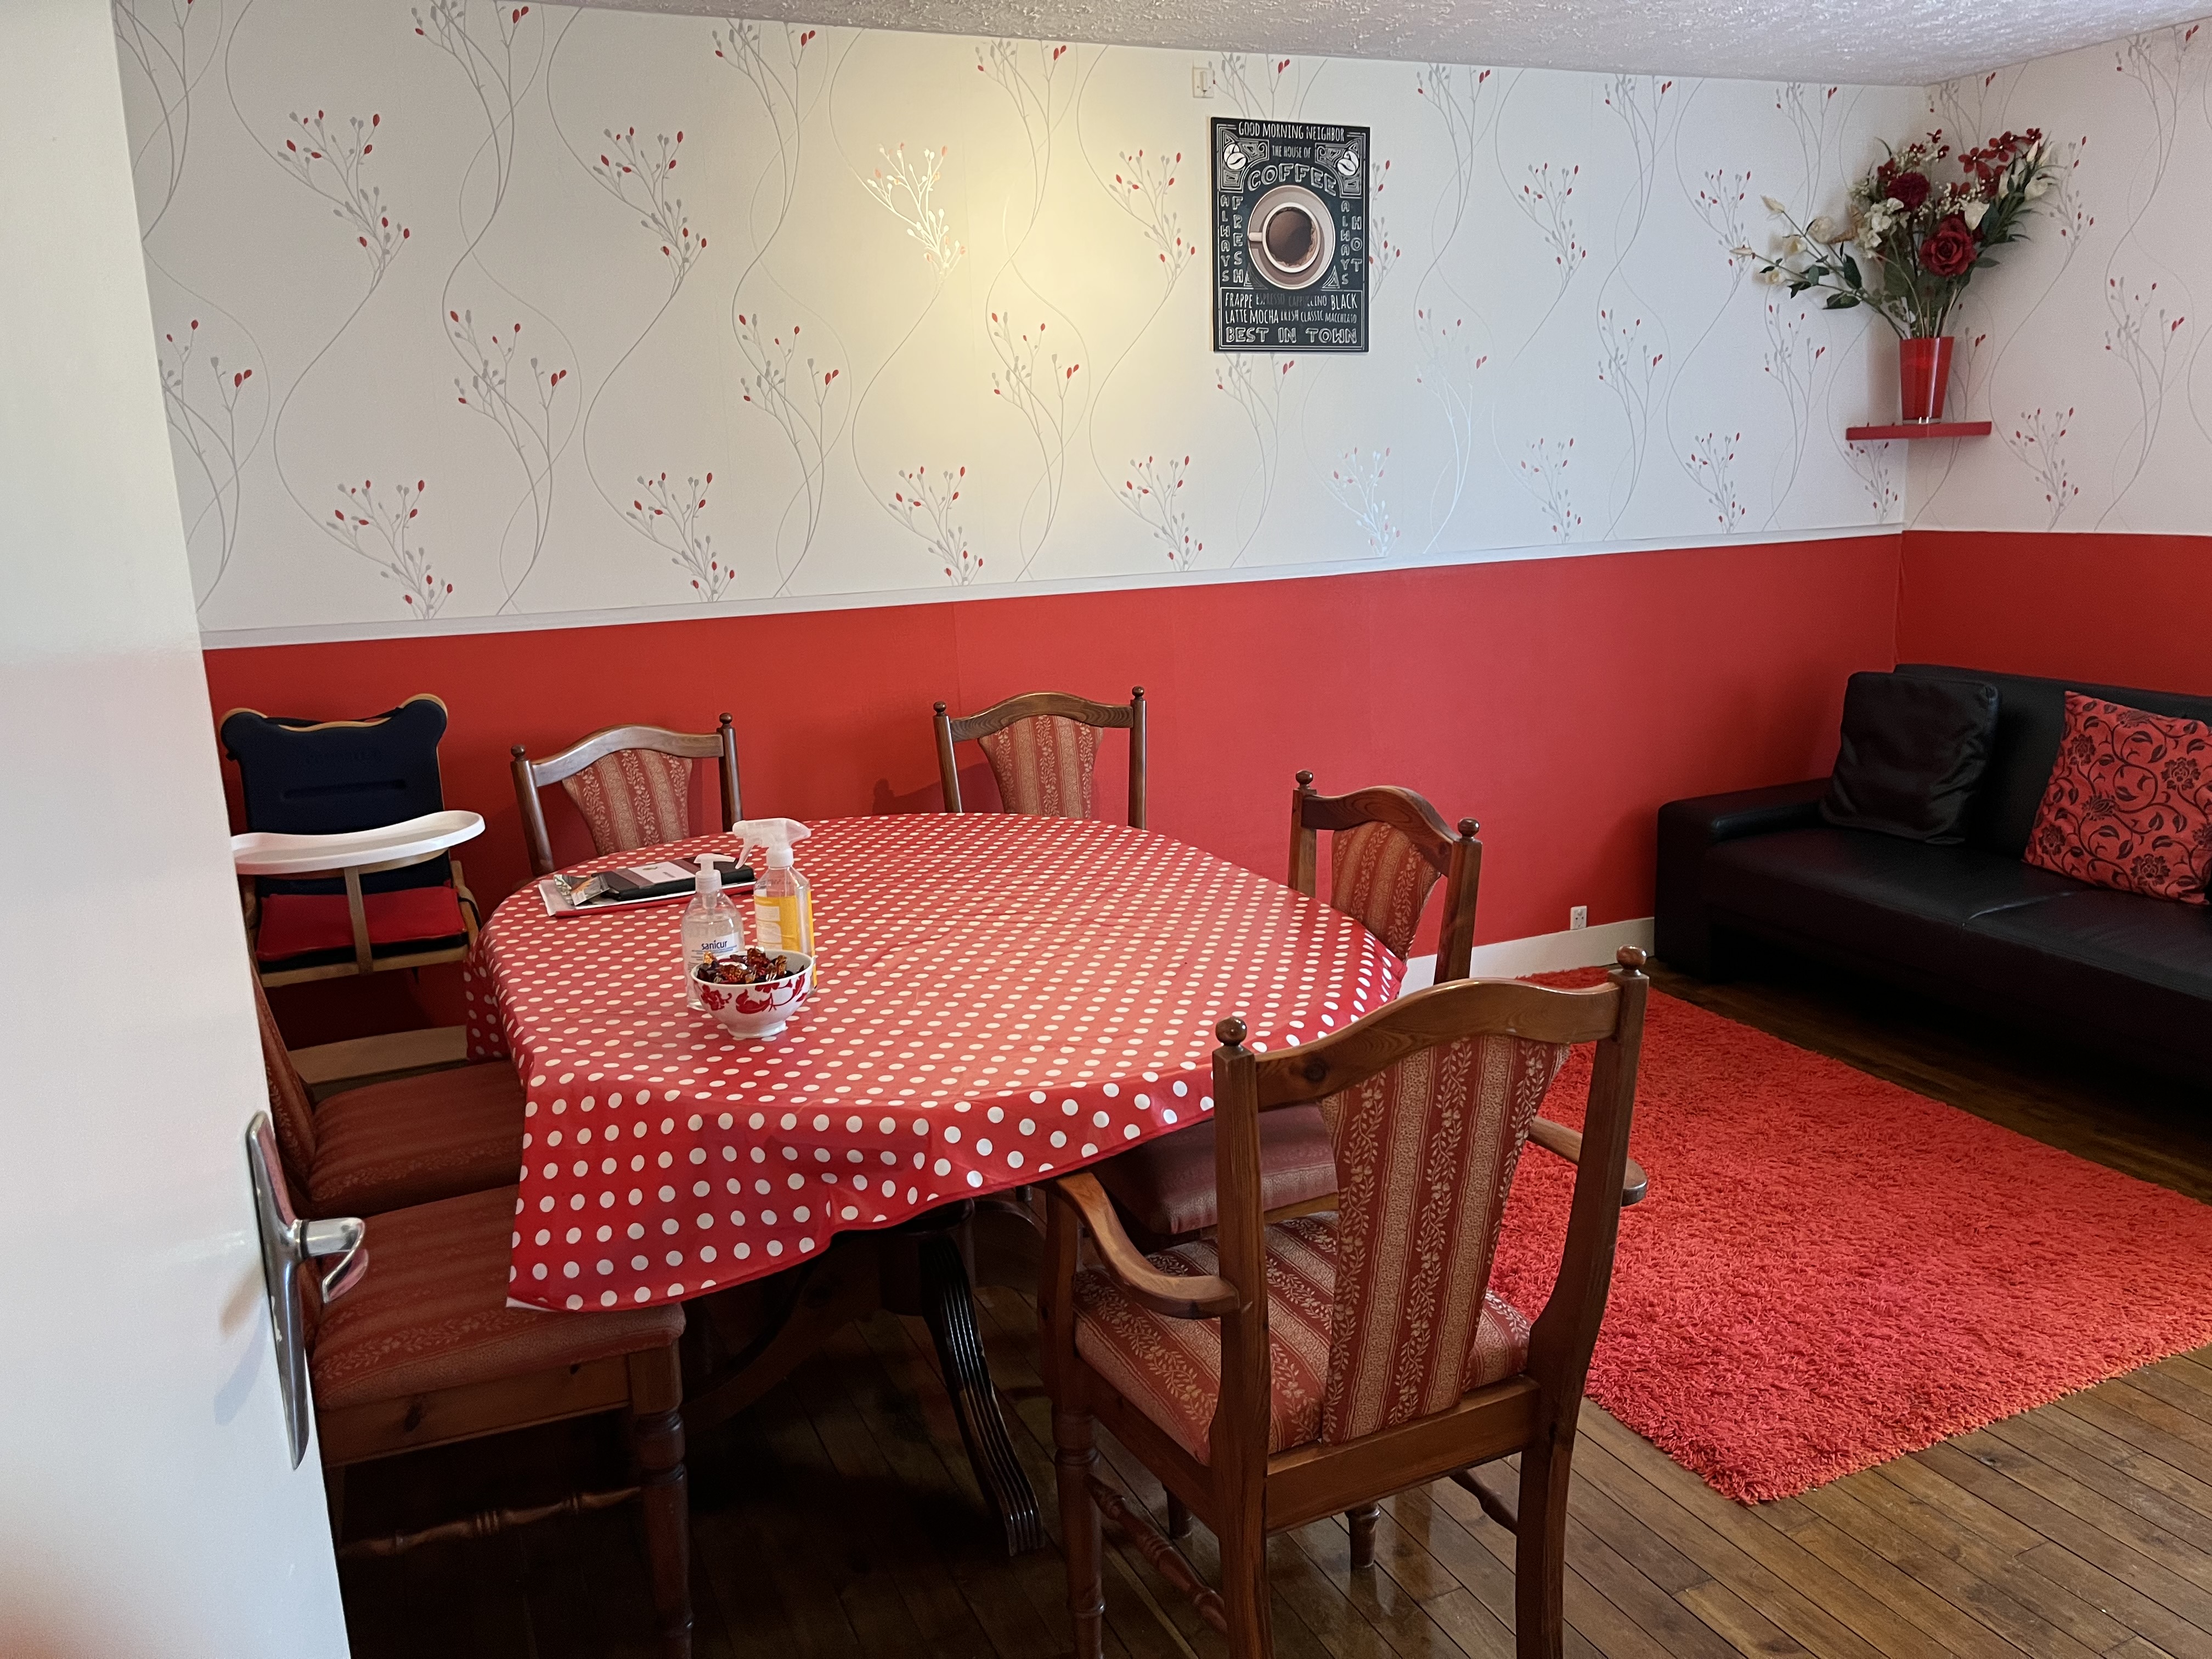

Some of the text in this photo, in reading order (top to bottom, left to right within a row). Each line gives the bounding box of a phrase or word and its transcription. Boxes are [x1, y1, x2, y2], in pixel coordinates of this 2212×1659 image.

[1239, 121, 1345, 142] GOOD MORNING NEIGHBOR
[1272, 145, 1312, 158] THE HOUSE OF
[1248, 163, 1336, 196] COFFEE
[1220, 195, 1231, 282] ALWAYS
[1232, 196, 1244, 283] FRESH
[1340, 200, 1350, 285] ALWAYS
[1350, 216, 1363, 272] HOT
[1225, 292, 1252, 308] FRAPPE
[1256, 294, 1285, 305] ESPRESSO
[1331, 293, 1358, 311] BLACK
[1225, 309, 1248, 324] LATTE
[1250, 309, 1279, 324] MOCHA
[1281, 309, 1299, 321] IRISH
[1301, 310, 1324, 323] CLASSIC
[1226, 327, 1358, 344] BEST IN TOWN
[701, 940, 728, 950] sanicur
